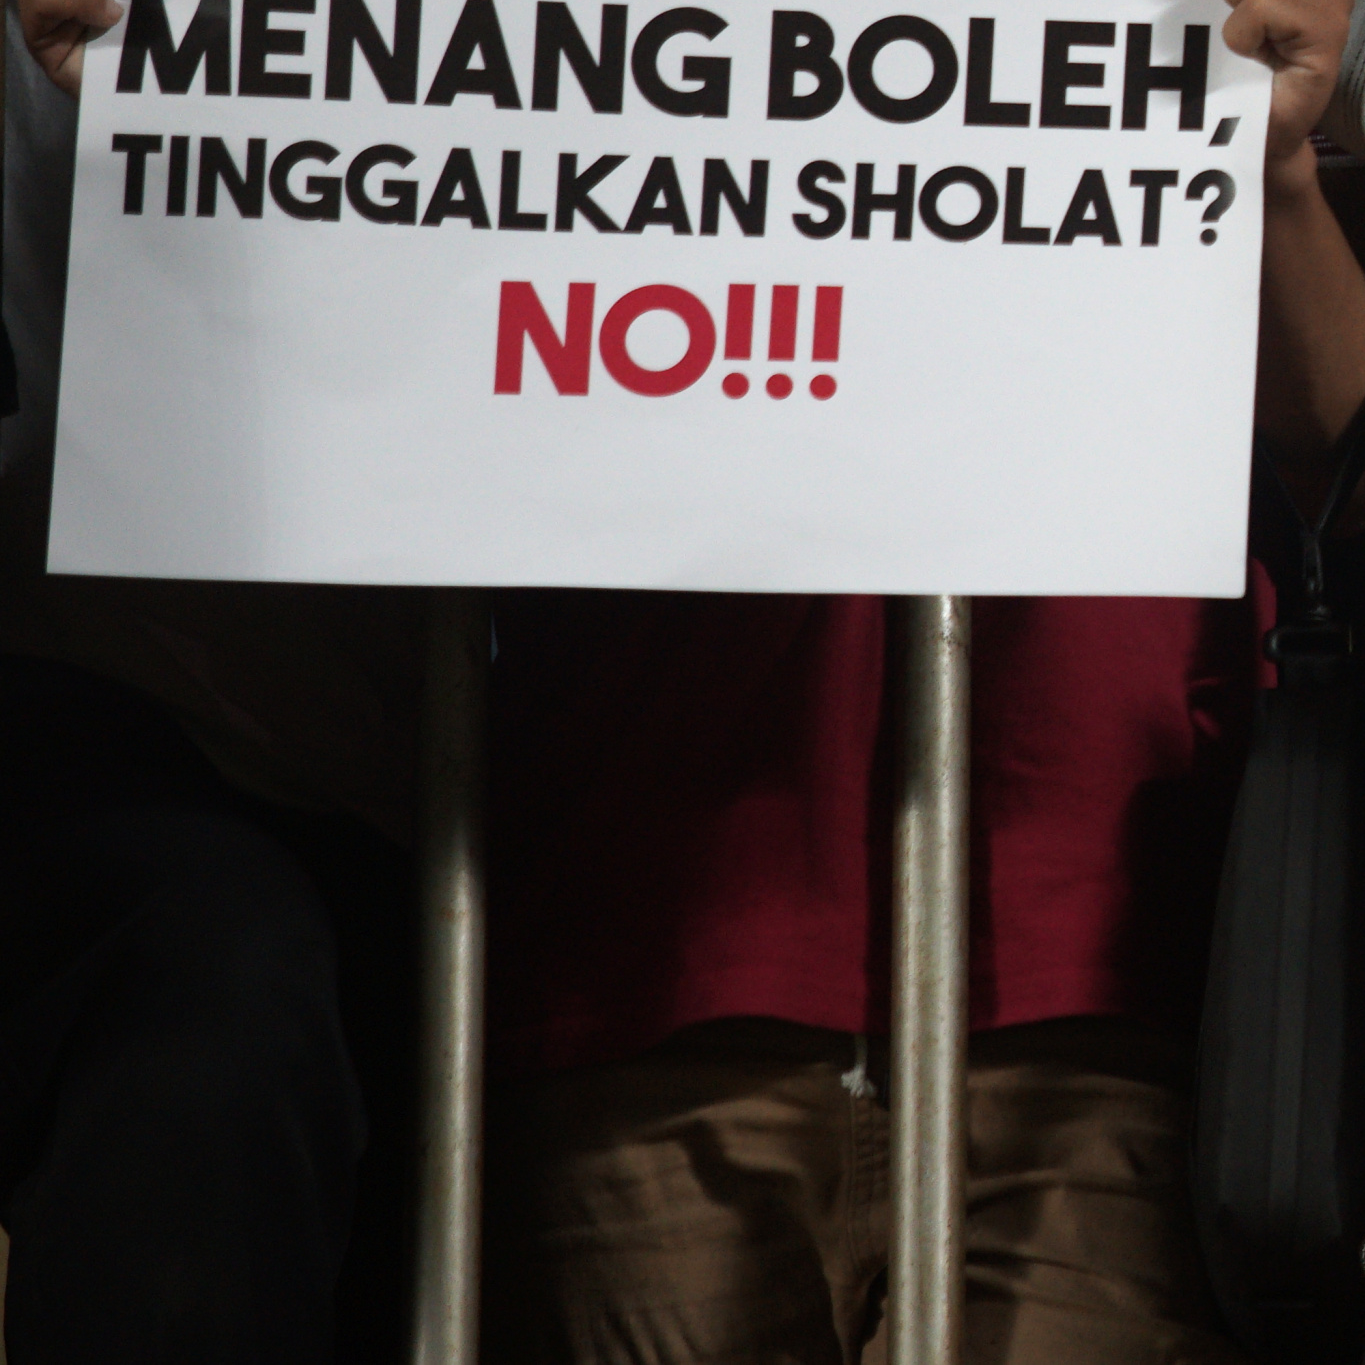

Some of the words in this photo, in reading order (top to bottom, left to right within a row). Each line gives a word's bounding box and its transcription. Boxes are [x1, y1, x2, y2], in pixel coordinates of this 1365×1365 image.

[766, 9, 1238, 147] BOLEH,
[110, 132, 770, 237] TINGGALKAN
[791, 159, 1235, 247] SHOLAT?
[493, 280, 844, 400] NO!!!
